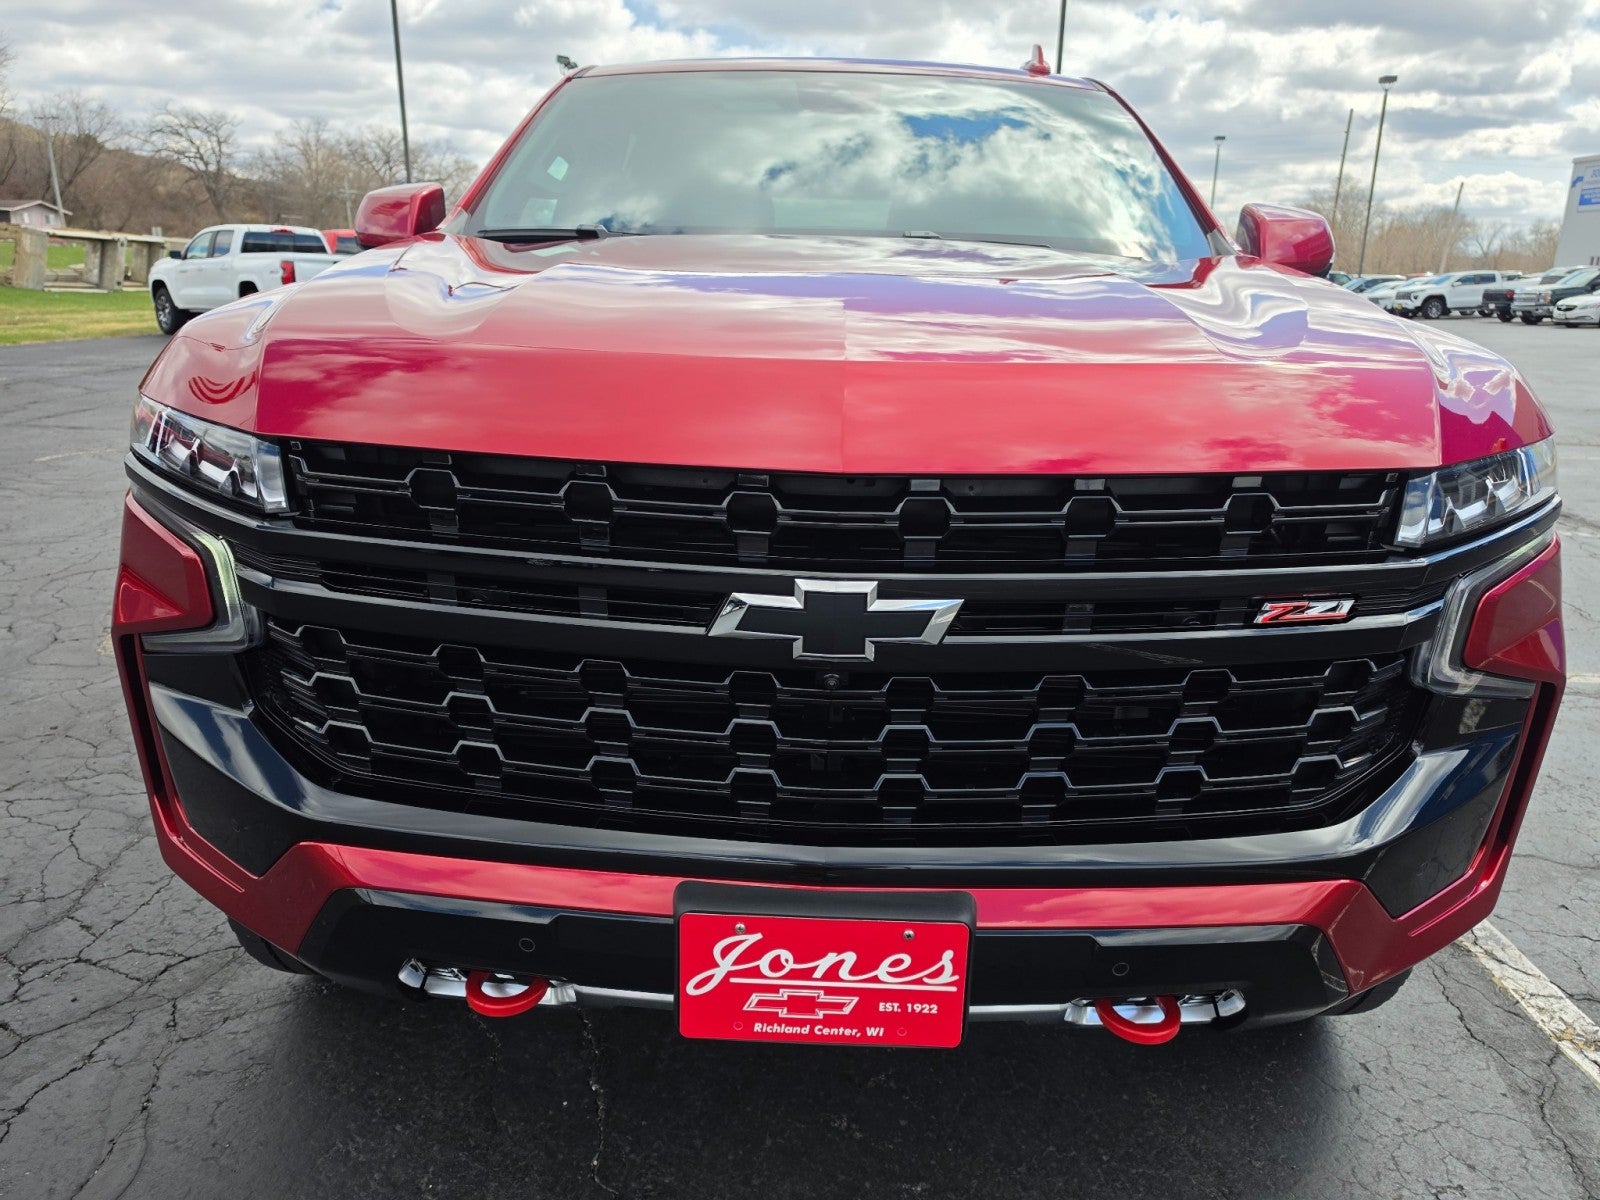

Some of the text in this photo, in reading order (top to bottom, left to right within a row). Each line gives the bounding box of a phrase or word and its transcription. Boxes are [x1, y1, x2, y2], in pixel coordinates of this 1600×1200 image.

[1253, 599, 1355, 623] Z71
[685, 932, 960, 996] Jones
[878, 1002, 938, 1014] EST. 1922
[753, 1022, 885, 1038] Richland Center, WI
